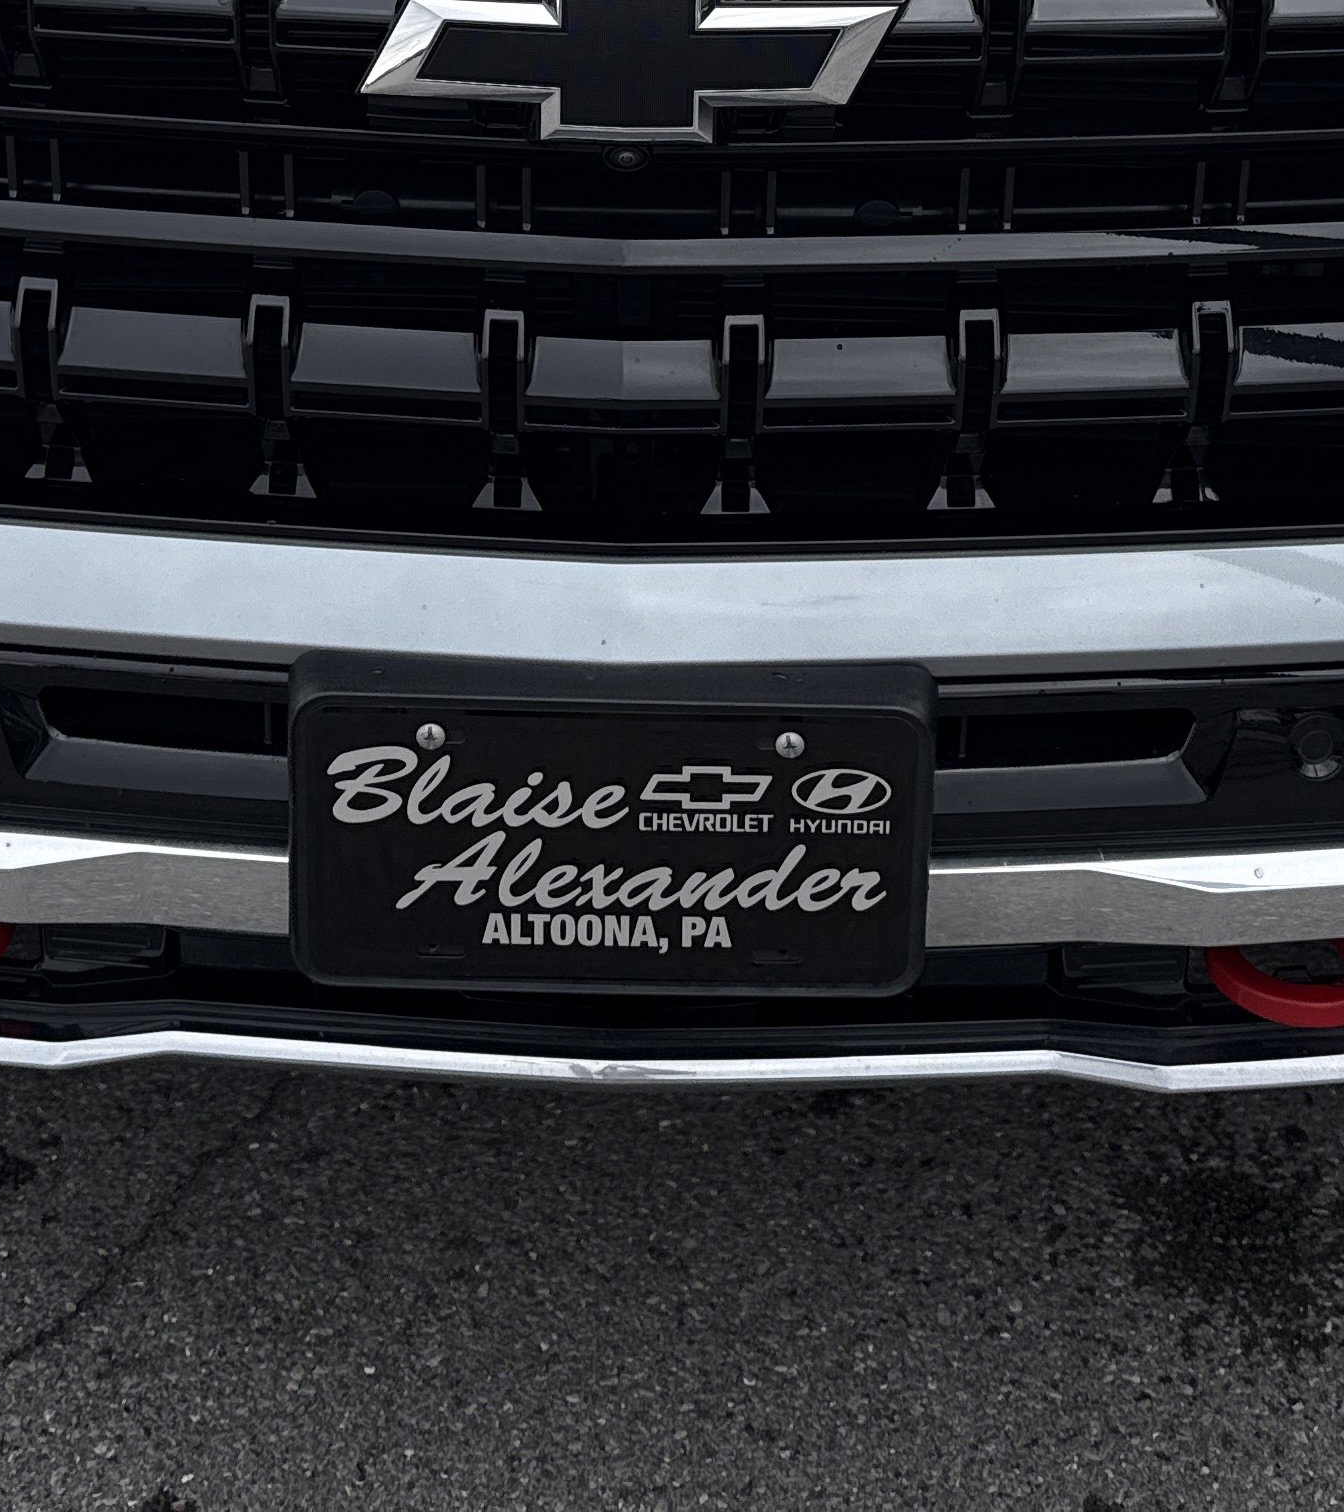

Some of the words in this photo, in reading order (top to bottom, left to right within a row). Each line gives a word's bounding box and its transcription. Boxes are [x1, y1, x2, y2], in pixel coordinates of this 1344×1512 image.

[327, 746, 629, 829] Blaise
[638, 813, 774, 833] CHEVROLET
[790, 819, 891, 835] HYUNDAI
[396, 831, 887, 912] Alexander
[482, 913, 669, 954] ALTOONA,
[681, 916, 732, 948] PA
